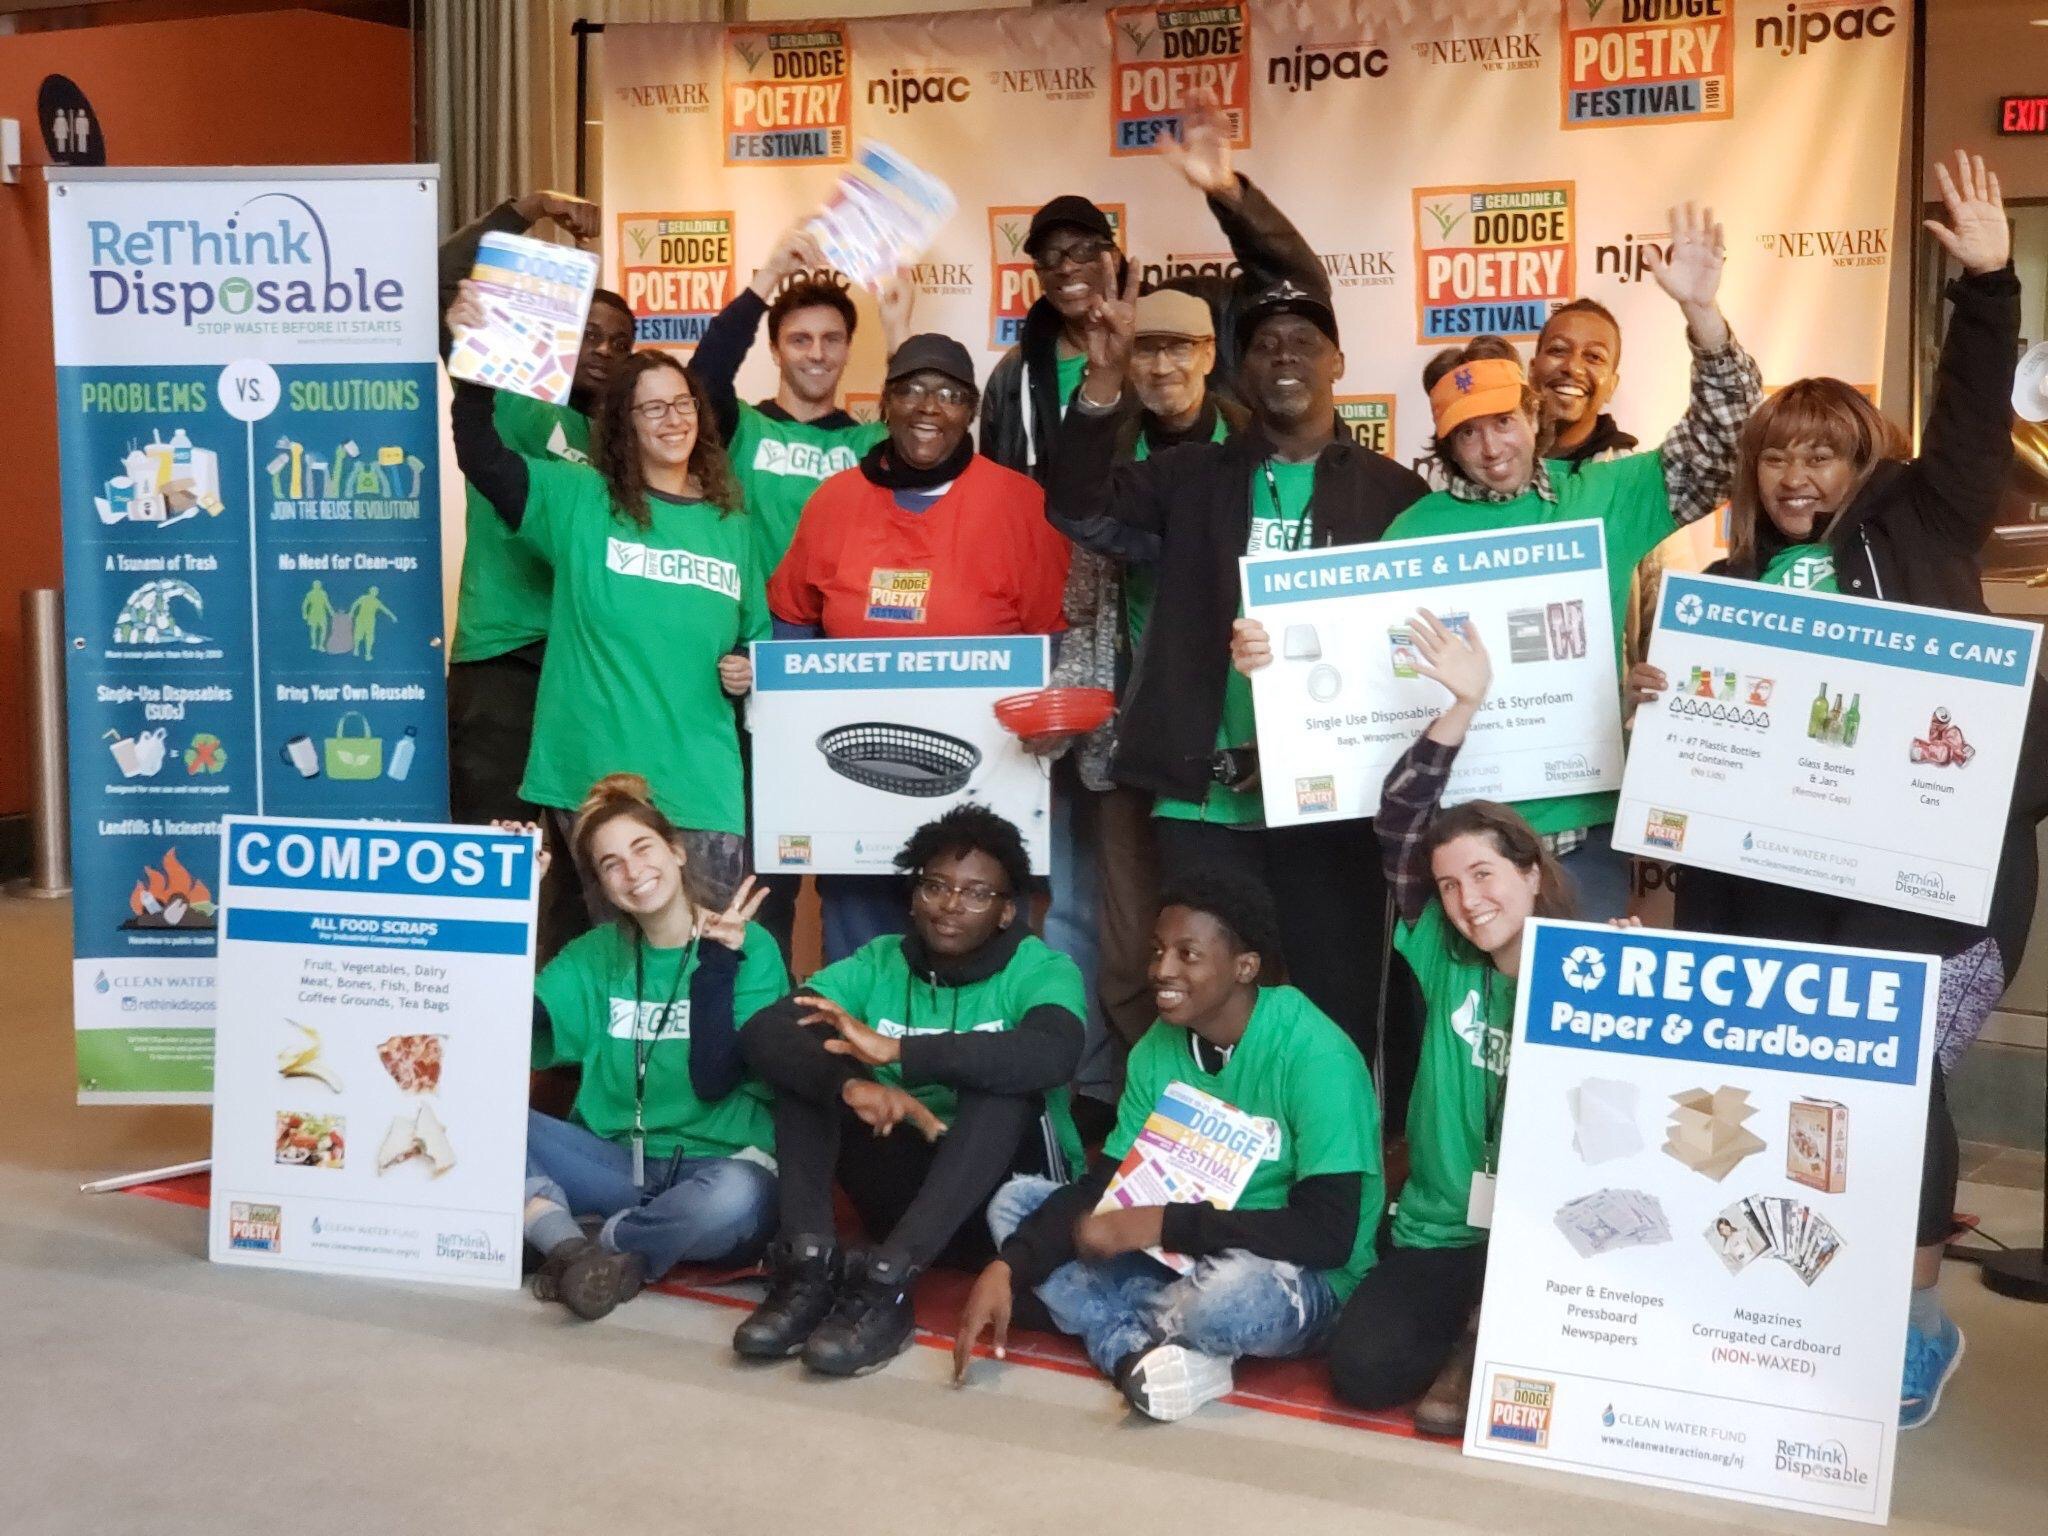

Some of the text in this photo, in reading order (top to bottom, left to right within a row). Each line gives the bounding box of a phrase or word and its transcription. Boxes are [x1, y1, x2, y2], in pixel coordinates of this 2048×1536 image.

[1163, 27, 1242, 58] DODGE
[1755, 3, 1896, 58] njpac
[1432, 33, 1542, 64] NEWARK
[1574, 24, 1721, 82] POETRY
[773, 50, 845, 78] DODGE
[1268, 45, 1389, 93] njpac
[868, 69, 971, 114] njpac
[1001, 66, 1098, 94] NEWARK
[630, 82, 710, 108] NEWARK
[733, 83, 842, 128] POETRY
[1575, 85, 1695, 118] FESTIVAL
[2003, 99, 2048, 132] EXIT
[735, 131, 826, 158] FESTIVAL
[1485, 191, 1565, 209] GERALDINE R.
[1474, 211, 1564, 244] DODGE
[88, 218, 312, 266] ReThink
[661, 237, 728, 265] DODGE
[1778, 229, 1889, 257] NEWARK
[911, 264, 974, 286] WARK
[1320, 251, 1398, 276] WARK
[1428, 249, 1565, 300] POETRY
[90, 268, 405, 326] Disposable
[628, 270, 727, 312] POETRY
[197, 320, 401, 335] STOP WASTE BEFORE IT STARTS
[1430, 304, 1542, 334] FESTIVAL
[81, 382, 207, 414] PROBLEMS
[236, 377, 265, 402] VS.
[290, 379, 420, 412] SOLUTIONS
[270, 500, 297, 520] JOIN
[298, 500, 319, 520] THE
[105, 555, 115, 571] A
[278, 553, 296, 571] No
[332, 553, 352, 571] for
[353, 553, 418, 573] Clean-ups
[660, 553, 739, 594] GREEN!
[1264, 540, 1586, 594] INCINERATE & LANDFILL
[870, 588, 926, 607] POETRY
[892, 578, 928, 590] DODGE
[1706, 603, 2018, 667] RECYCLE BOTTLES & CANS
[784, 649, 1012, 675] BASKET RETURN
[276, 684, 425, 704] Bring Your Own Reusable
[1306, 716, 1342, 731] Single
[1346, 713, 1368, 726] Use
[1371, 705, 1442, 724] Disposables
[1511, 692, 1574, 710] Styrofoam
[1362, 731, 1408, 744] Wrappers,
[1516, 716, 1546, 727] Straws
[1678, 750, 1744, 770] and Containers
[1700, 739, 1728, 753] Plastic
[1730, 744, 1761, 759] Bottles
[1798, 756, 1856, 777] Glass Bottles
[1819, 775, 1838, 788] Jars
[1910, 777, 1956, 796] Aluminum
[1919, 794, 1941, 808] Cans
[237, 832, 526, 888] COMPOST
[1756, 839, 1859, 868] CLEAN WATER FUND
[1895, 880, 1956, 902] Disposable
[1897, 871, 1940, 889] ReThink
[310, 917, 439, 936] ALL FOOD SCRAPS
[114, 976, 216, 988] CLEAN WATER
[342, 961, 410, 977] Vegetables,
[415, 964, 447, 979] Dairy
[1617, 946, 1902, 1022] RECYCLE
[337, 977, 376, 992] Bones,
[414, 981, 450, 994] Bread
[298, 990, 450, 1013] Coffee Grounds, Tea Bags
[1550, 1001, 1900, 1068] Paper & Cardboard
[1178, 1128, 1249, 1170] POETRY
[1189, 1110, 1262, 1160] DODGE
[1172, 1142, 1240, 1188] FESTIVAL
[1545, 1279, 1665, 1311] Paper & Envelopes
[1567, 1304, 1638, 1325] Pressboard
[1733, 1307, 1802, 1329] Magazines
[1561, 1324, 1638, 1347] Newspapers
[1692, 1324, 1842, 1357] Corrugated Cardboard
[1711, 1347, 1817, 1377] (NON-WAXED)
[1514, 1389, 1550, 1407] DODGE
[1494, 1405, 1547, 1428] POETRY
[1619, 1412, 1747, 1444] CLEAN WATER FUND
[1601, 1433, 1745, 1469] www.cleanwateraction.org/nj
[1777, 1439, 1845, 1465] ReThink
[1775, 1454, 1869, 1485] Disposable
